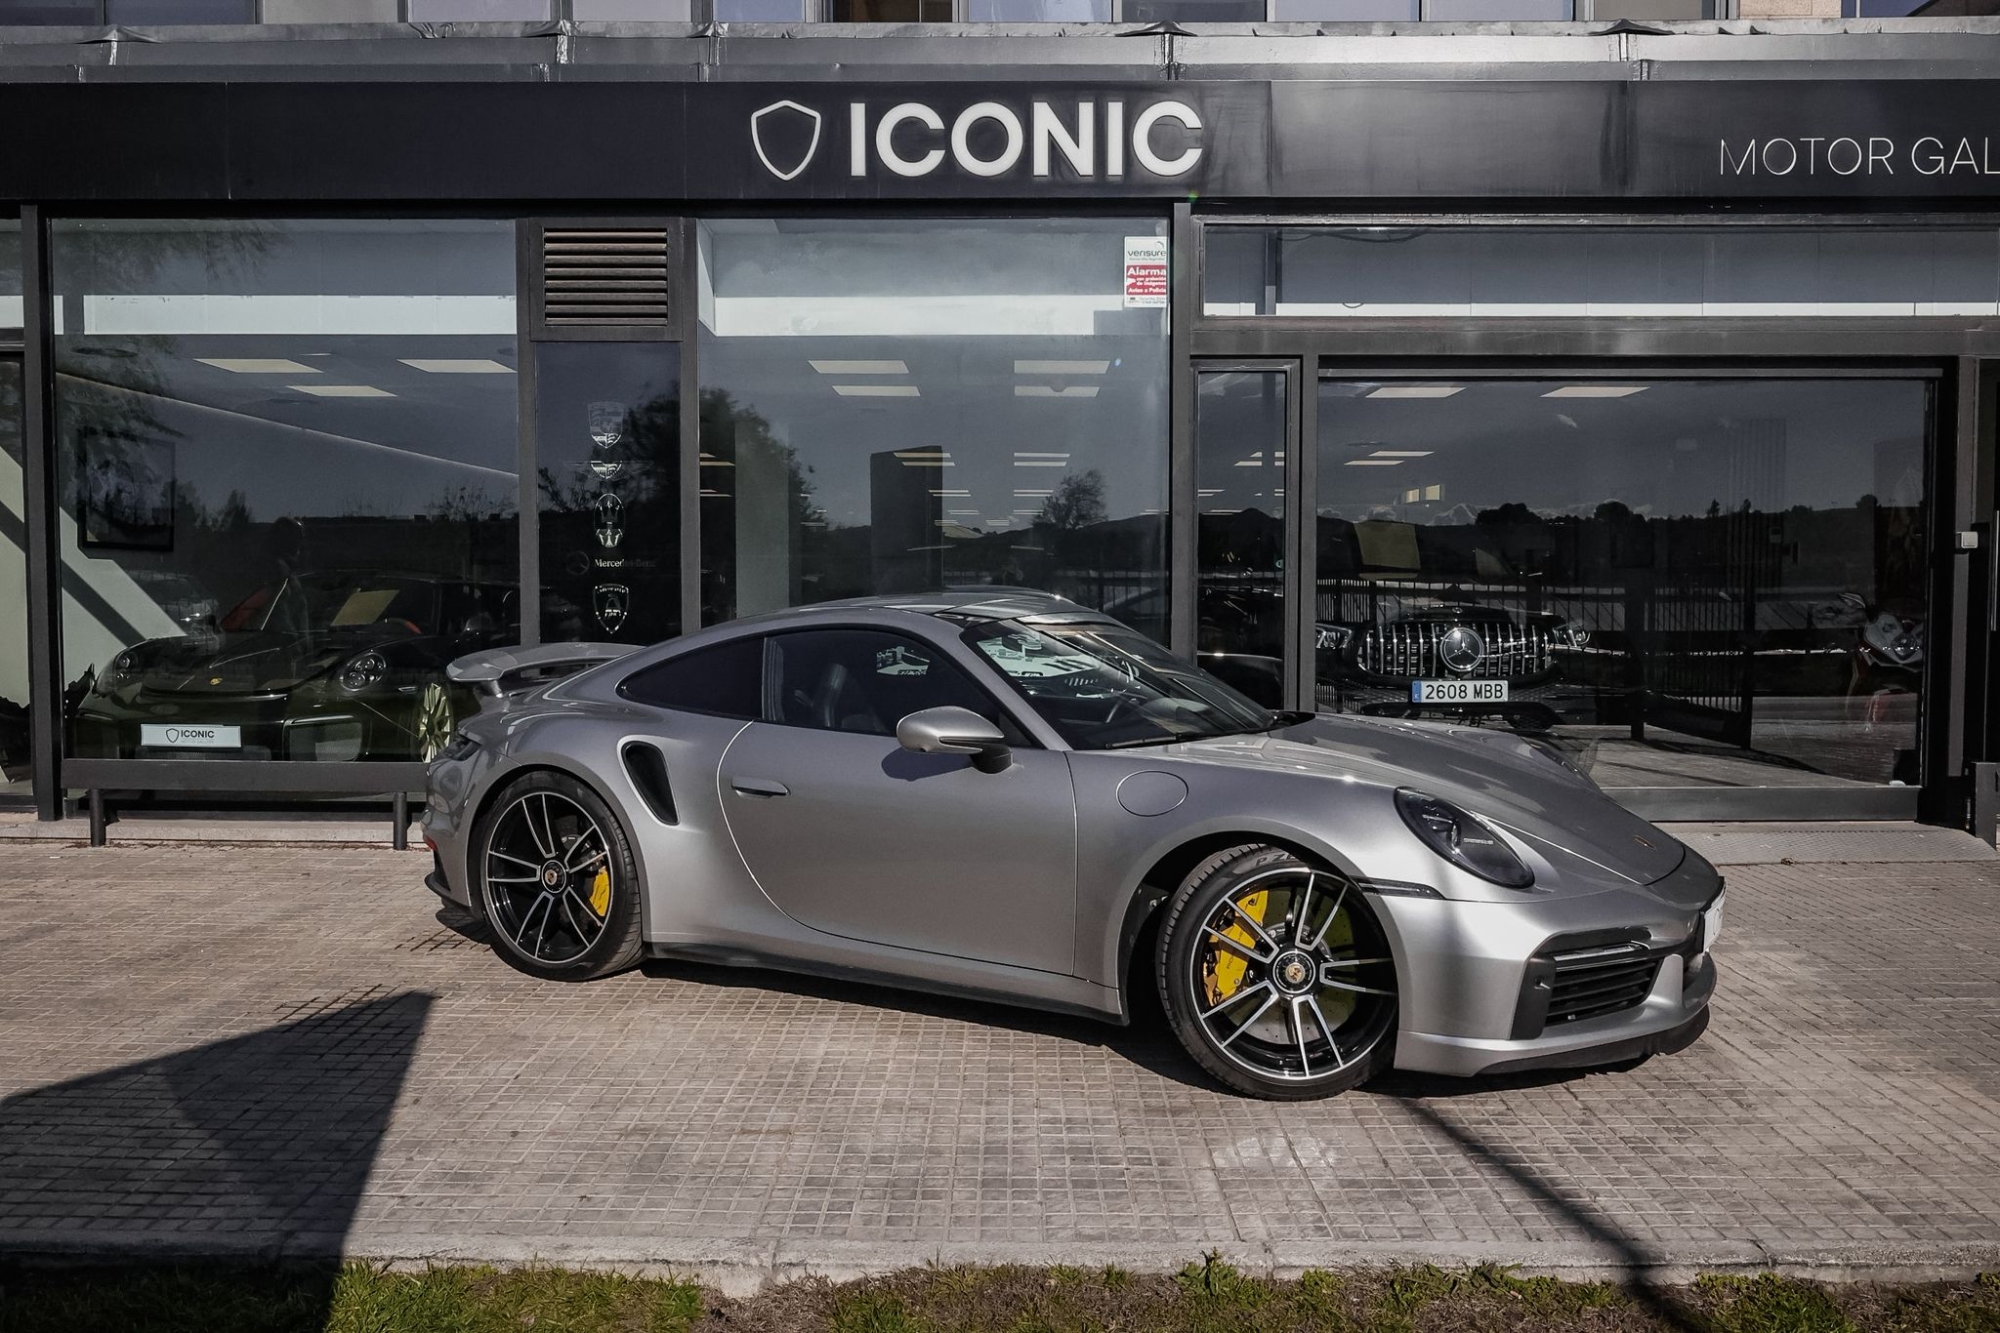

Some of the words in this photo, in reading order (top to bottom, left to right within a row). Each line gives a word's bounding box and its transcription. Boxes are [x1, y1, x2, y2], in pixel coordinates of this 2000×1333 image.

[850, 101, 1203, 177] ICONIC
[1720, 137, 1894, 175] MOTOR
[1127, 266, 1167, 276] Alarma
[1425, 684, 1468, 700] 2608
[1473, 684, 1503, 700] MBB
[180, 729, 215, 739] ICONIC
